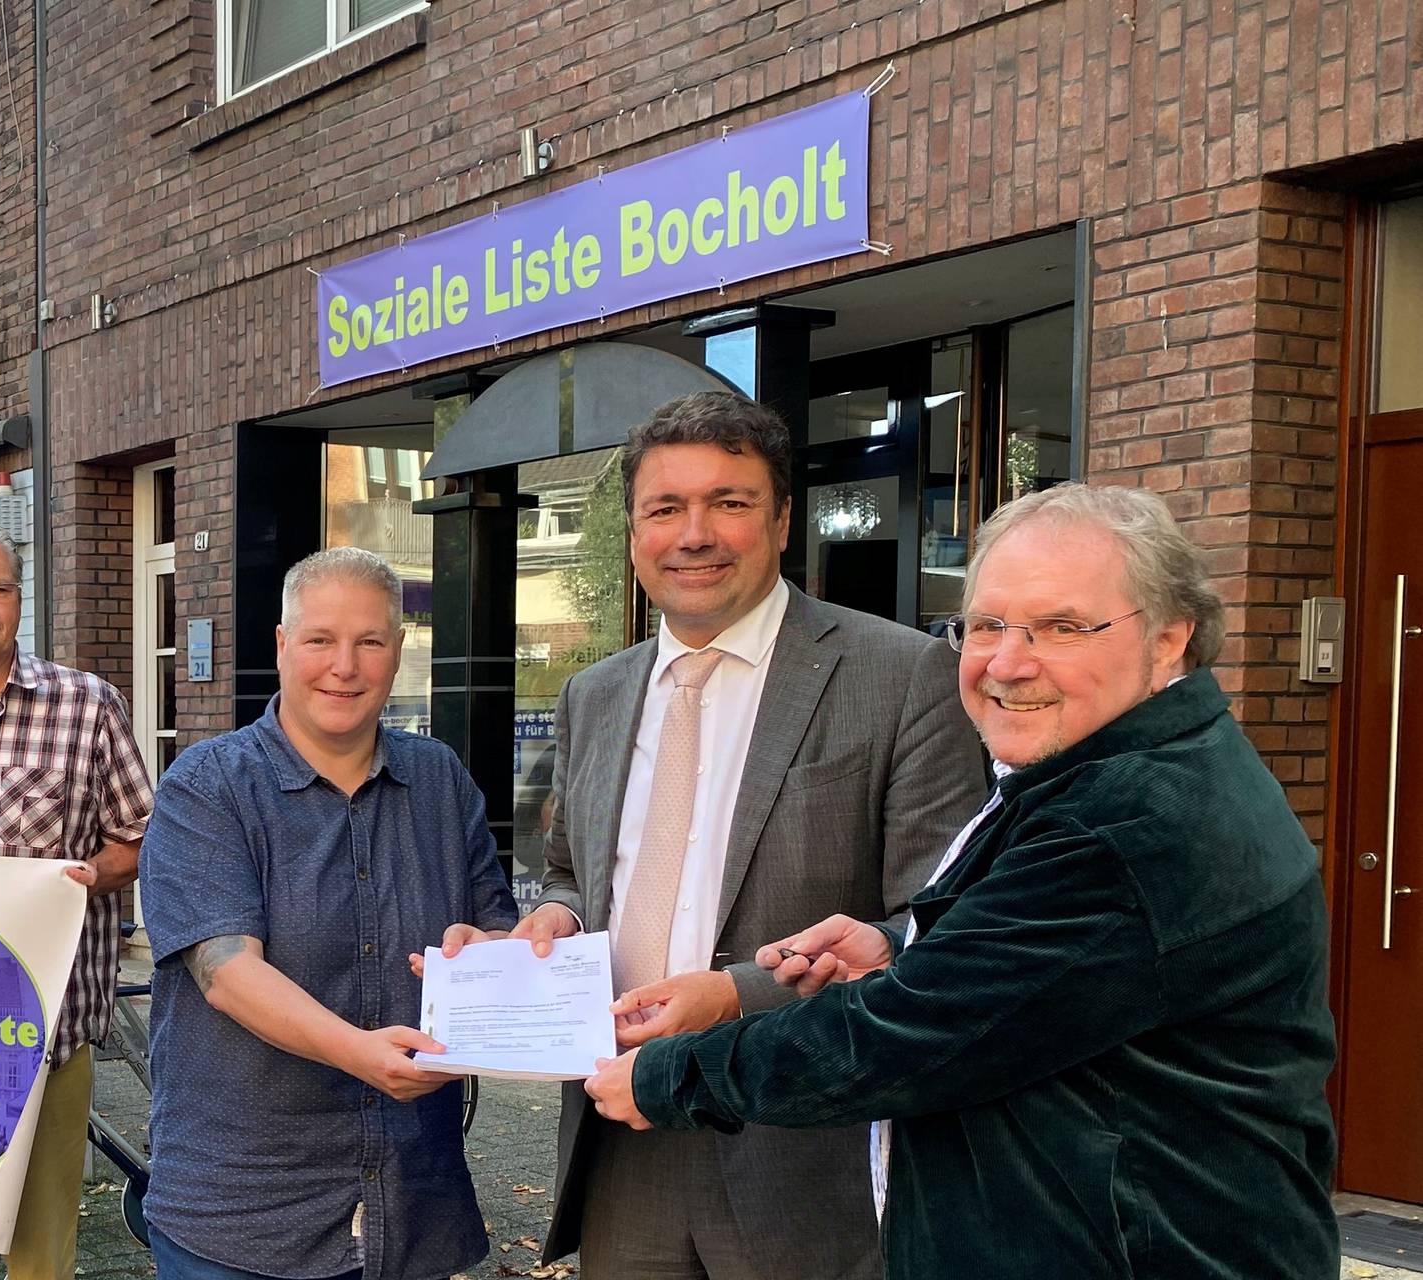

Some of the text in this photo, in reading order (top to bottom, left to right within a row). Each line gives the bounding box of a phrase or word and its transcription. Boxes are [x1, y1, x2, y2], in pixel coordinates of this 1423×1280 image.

[328, 139, 848, 358] Soziale Liste Bocholt
[196, 533, 206, 549] 21
[194, 661, 205, 677] 21
[524, 725, 544, 736] für
